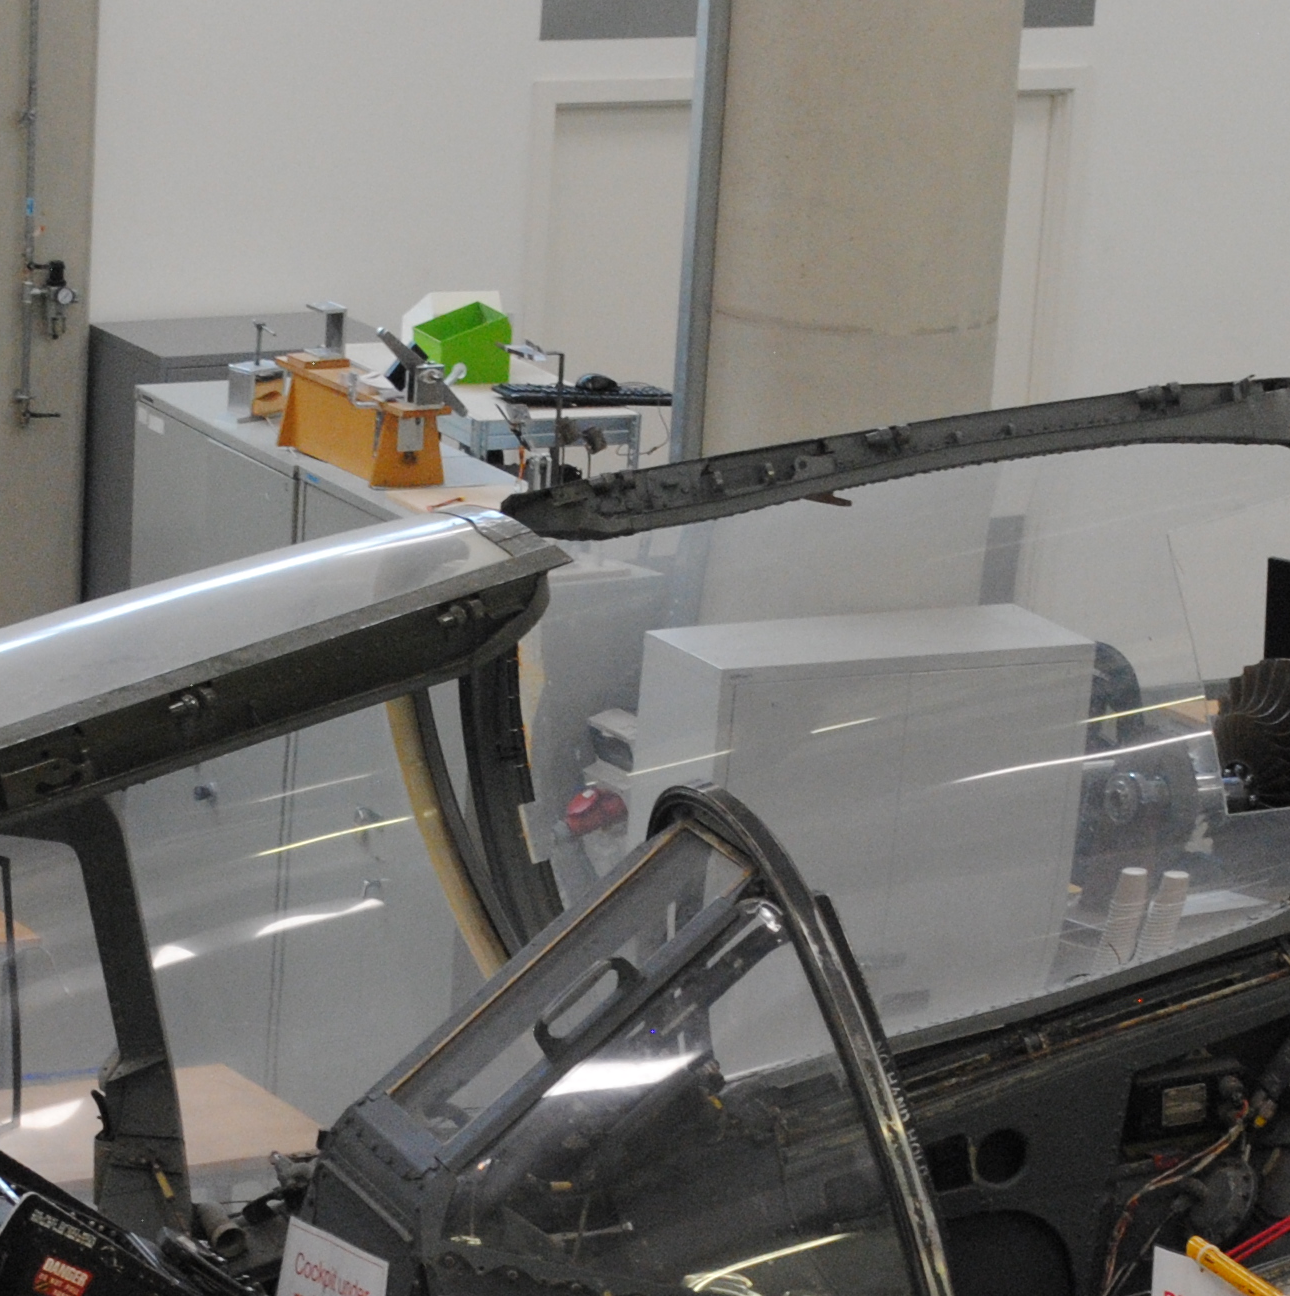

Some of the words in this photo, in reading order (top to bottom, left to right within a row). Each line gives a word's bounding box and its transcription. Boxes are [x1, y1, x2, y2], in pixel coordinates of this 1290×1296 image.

[886, 1072, 911, 1122] HAND
[42, 1257, 89, 1288] DANGER
[294, 1252, 338, 1296] Cockpit
